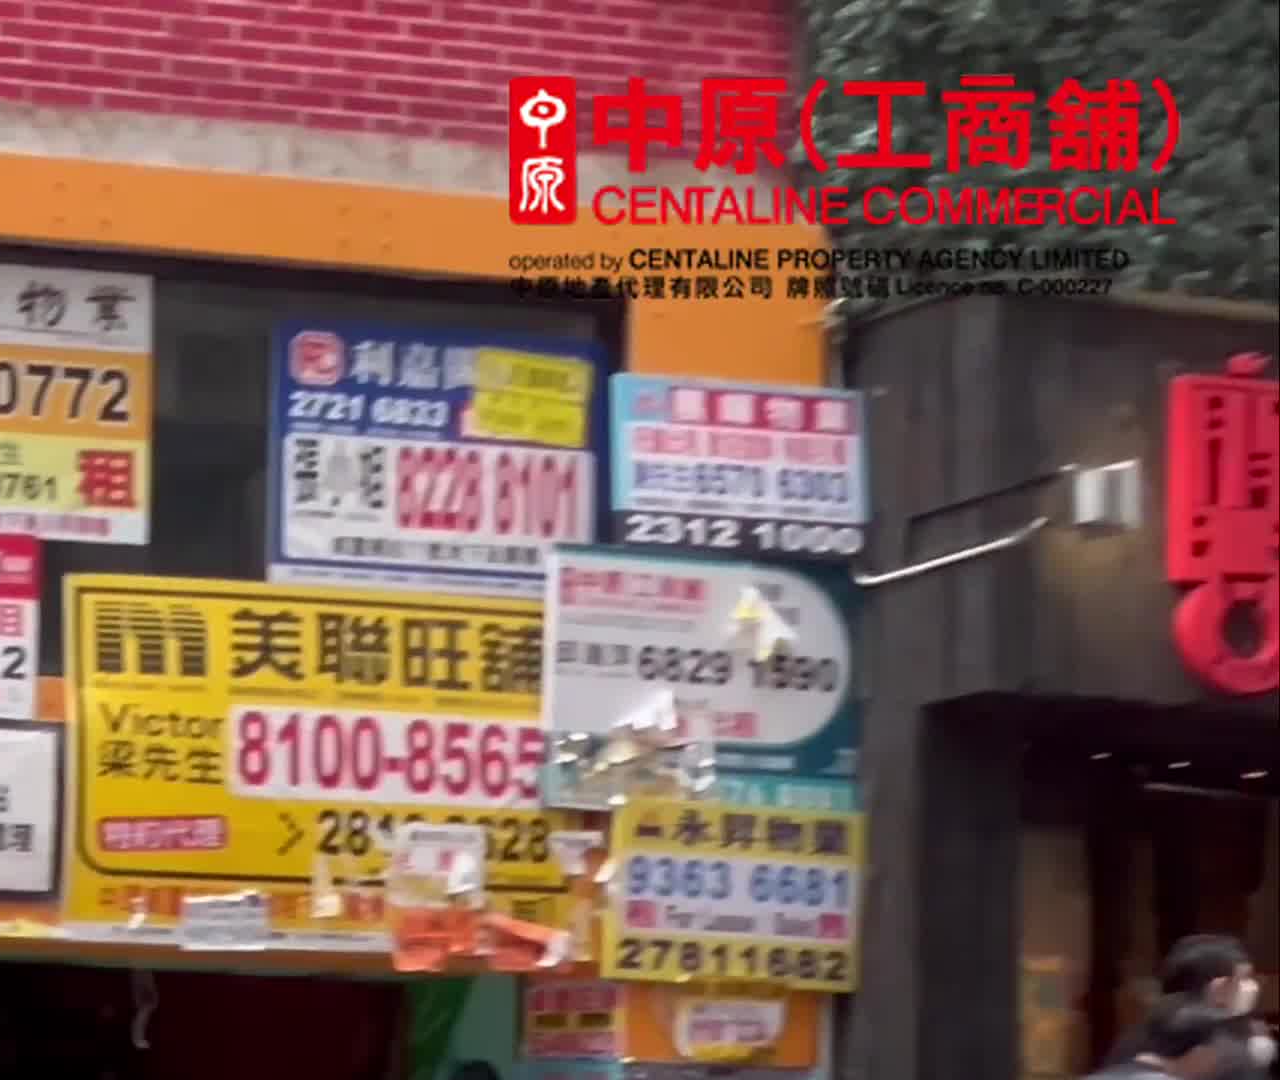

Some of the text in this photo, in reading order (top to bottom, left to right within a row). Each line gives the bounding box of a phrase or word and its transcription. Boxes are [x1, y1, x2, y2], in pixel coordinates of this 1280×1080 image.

[76, 449, 138, 510] 租
[625, 514, 743, 549] 2312
[230, 609, 544, 692] 美聯旺舖
[98, 703, 223, 739] Victor
[236, 710, 547, 799] 8100-8565
